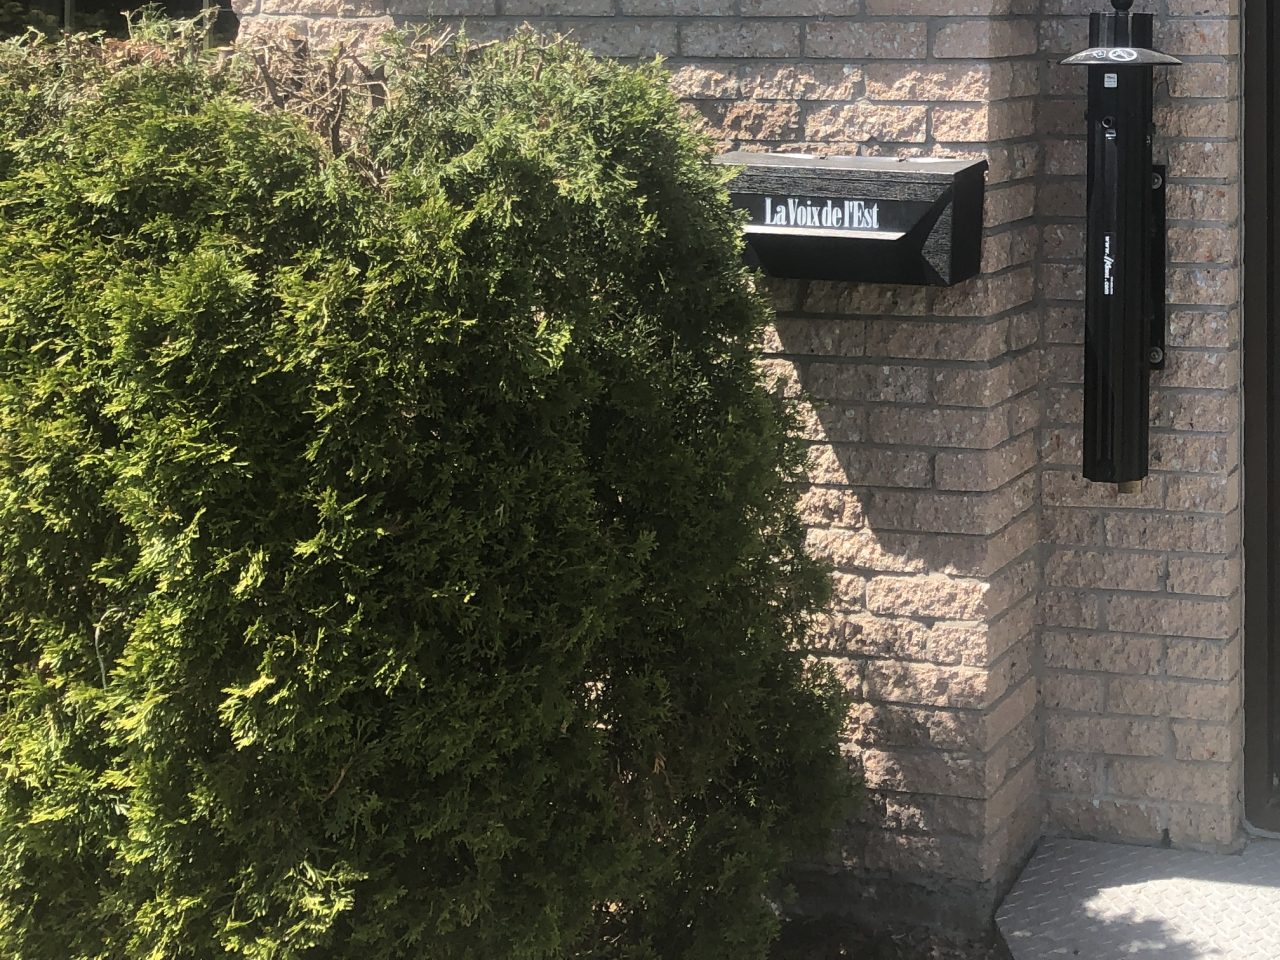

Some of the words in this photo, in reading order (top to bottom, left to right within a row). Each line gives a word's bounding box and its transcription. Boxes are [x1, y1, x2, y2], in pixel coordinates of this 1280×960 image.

[787, 197, 820, 227] Voix
[821, 199, 842, 228] de
[843, 200, 880, 229] l'Est
